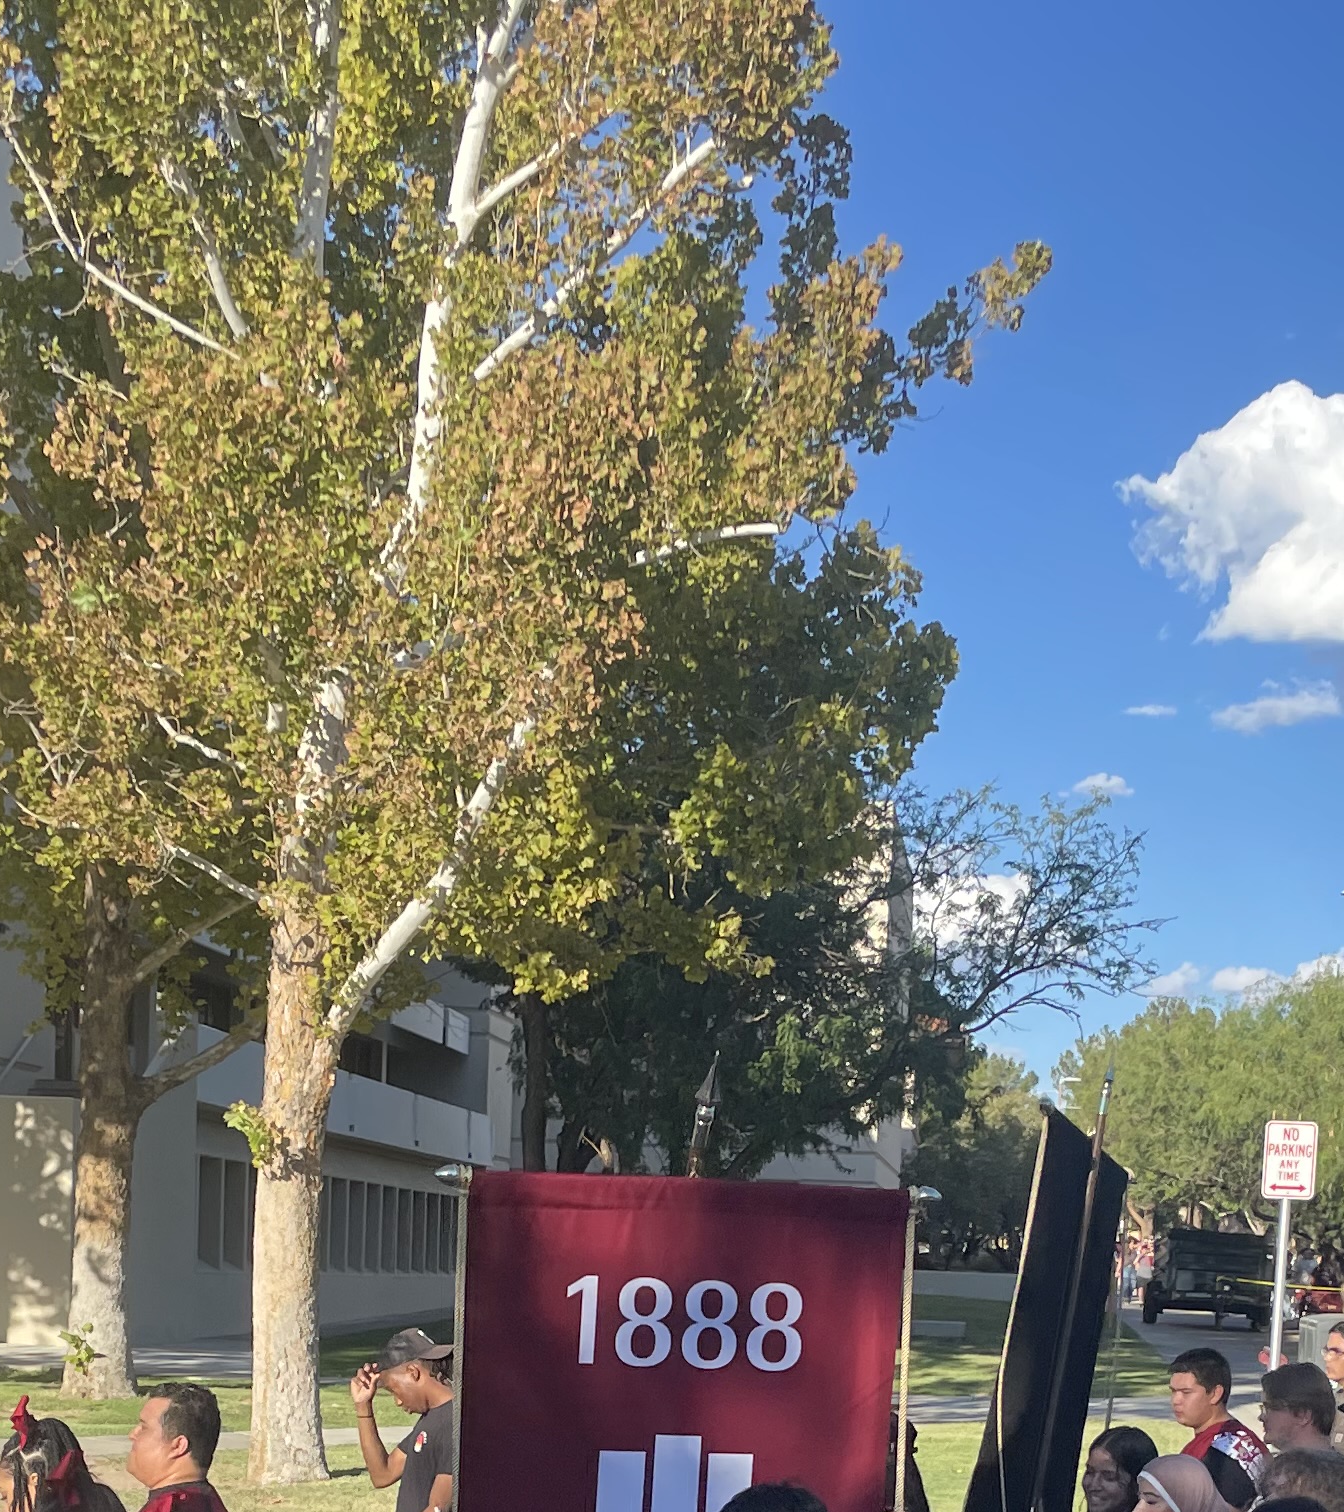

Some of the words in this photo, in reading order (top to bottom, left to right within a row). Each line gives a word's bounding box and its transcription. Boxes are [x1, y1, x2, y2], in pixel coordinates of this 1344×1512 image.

[1283, 1128, 1299, 1141] NO
[1268, 1143, 1313, 1158] PARKING
[1279, 1160, 1299, 1169] ANY
[1278, 1172, 1299, 1181] TIME
[566, 1274, 803, 1372] 1888
